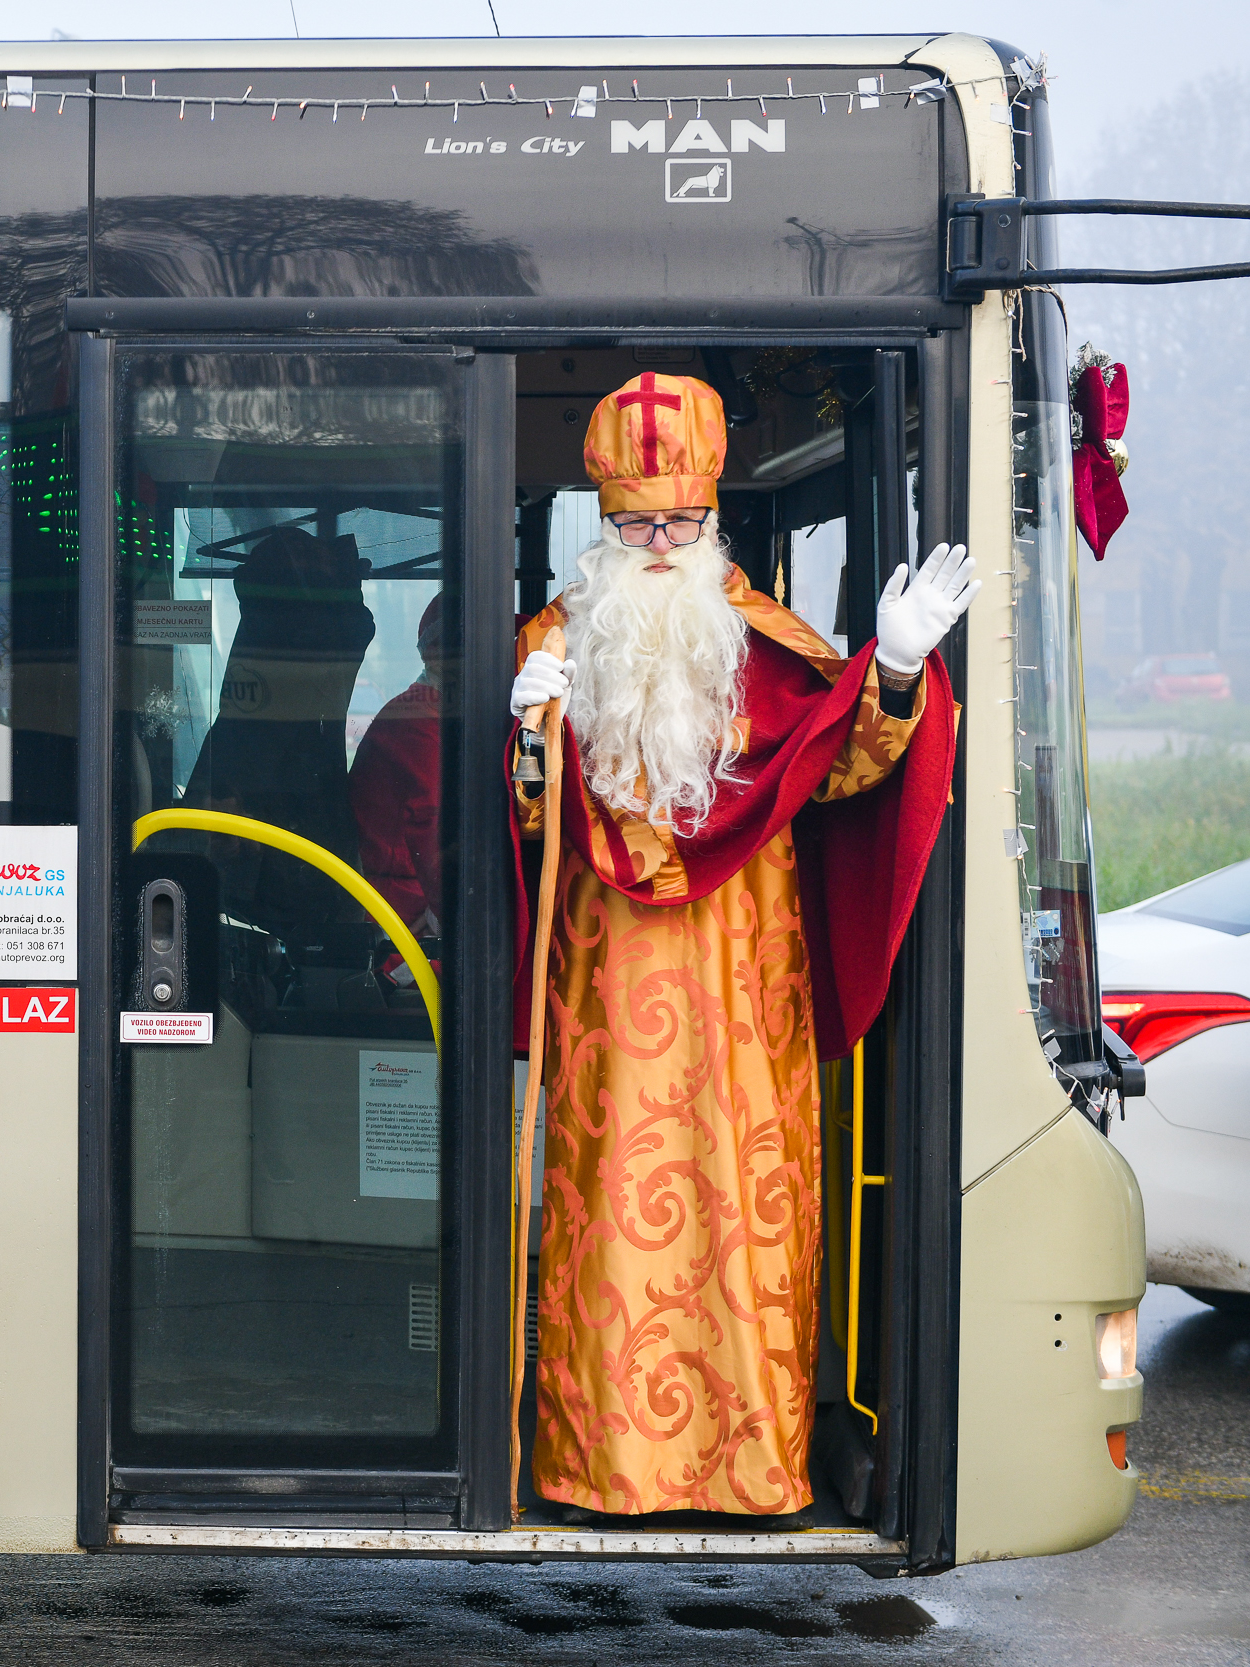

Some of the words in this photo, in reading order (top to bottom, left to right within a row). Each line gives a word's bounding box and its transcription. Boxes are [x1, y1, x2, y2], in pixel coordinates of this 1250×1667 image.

[610, 119, 786, 153] MAN
[423, 136, 507, 154] Lion's
[520, 136, 586, 157] City
[137, 617, 177, 625] MJESEČNU
[44, 869, 65, 881] GS
[36, 914, 65, 923] d.o.o.
[41, 926, 65, 935] br.35
[6, 941, 23, 950] 051
[27, 941, 45, 950] 308
[47, 941, 65, 950] 671
[158, 1028, 196, 1036] NADZOROM
